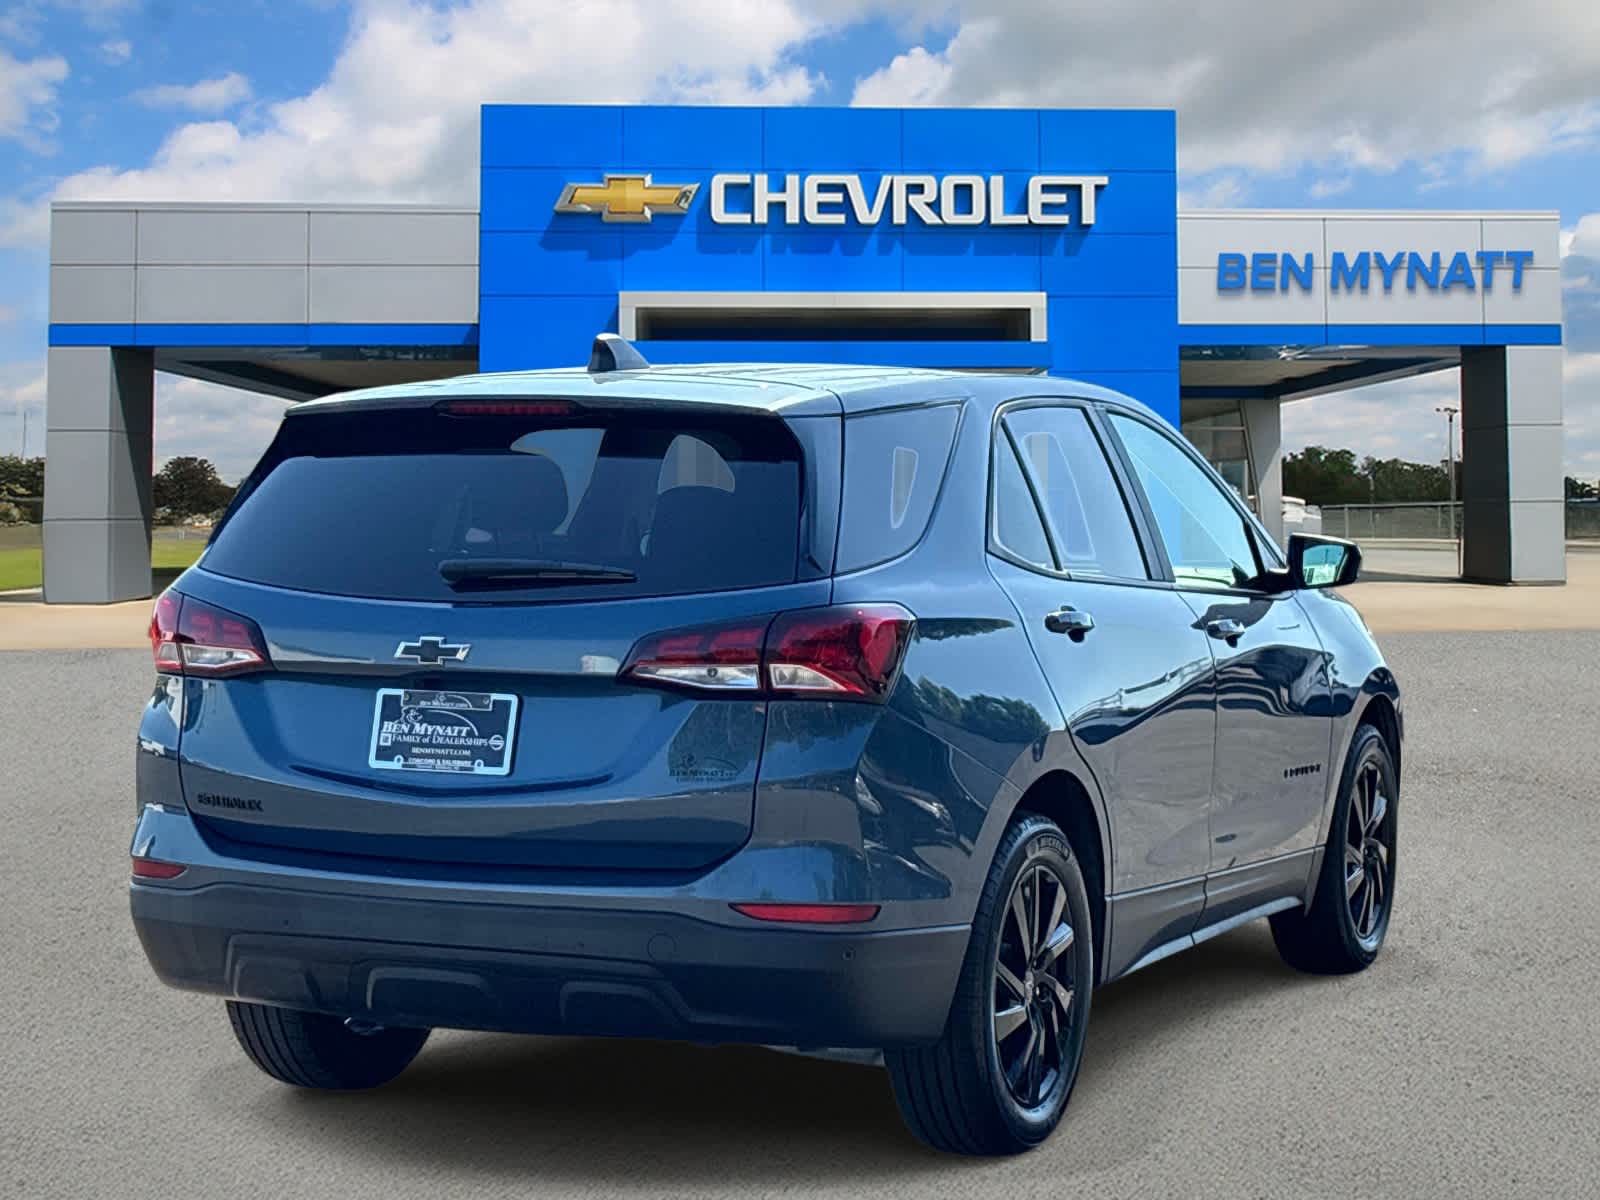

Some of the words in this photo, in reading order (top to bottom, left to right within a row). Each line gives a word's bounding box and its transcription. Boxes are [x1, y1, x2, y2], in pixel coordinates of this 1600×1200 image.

[711, 173, 1109, 225] CHEVROLET
[1217, 252, 1313, 290] BEN
[1330, 250, 1534, 290] MYNATT
[382, 721, 410, 734] BEN
[412, 723, 471, 737] MYNATT
[392, 734, 421, 744] FAMILY
[431, 735, 489, 747] DEALERSHIPS
